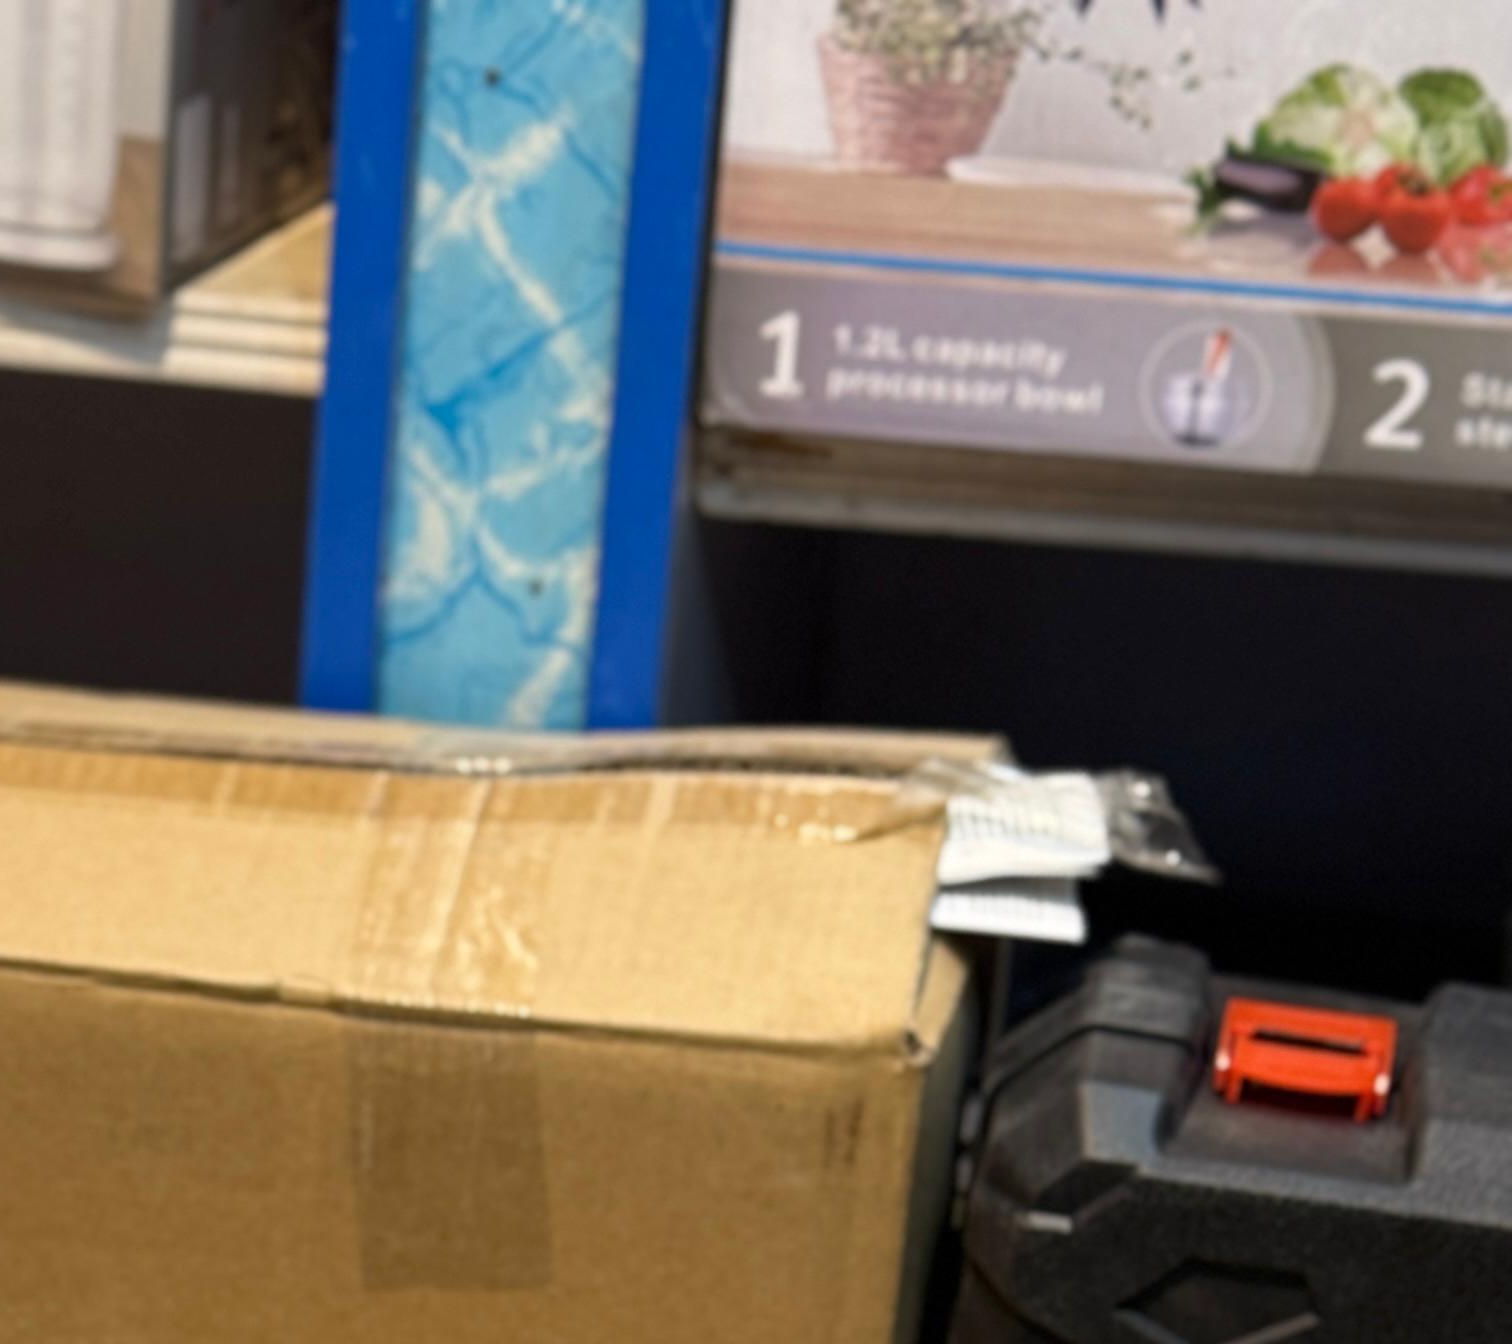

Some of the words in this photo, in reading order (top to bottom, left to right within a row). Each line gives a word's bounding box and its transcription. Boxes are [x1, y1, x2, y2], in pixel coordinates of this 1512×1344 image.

[760, 310, 804, 397] 1
[912, 334, 1067, 381] capacity
[826, 369, 1010, 403] processor
[1014, 377, 1103, 413] bowl
[1364, 358, 1430, 447] 2
